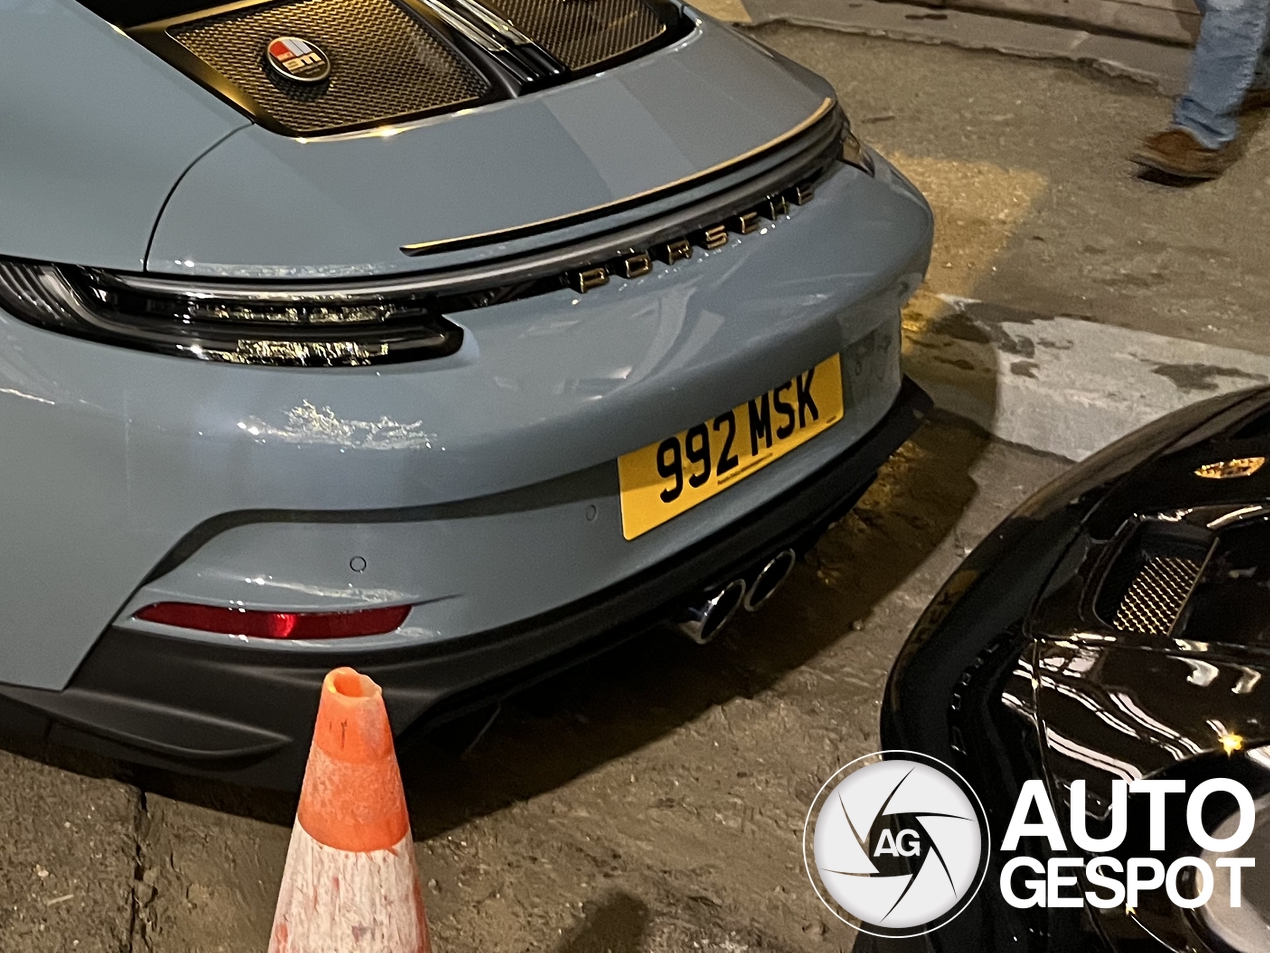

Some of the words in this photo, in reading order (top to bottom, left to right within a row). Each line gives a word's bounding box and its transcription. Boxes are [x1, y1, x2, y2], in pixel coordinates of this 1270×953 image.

[580, 186, 814, 294] PORSCHE
[656, 410, 739, 503] 992
[748, 367, 819, 457] MSK
